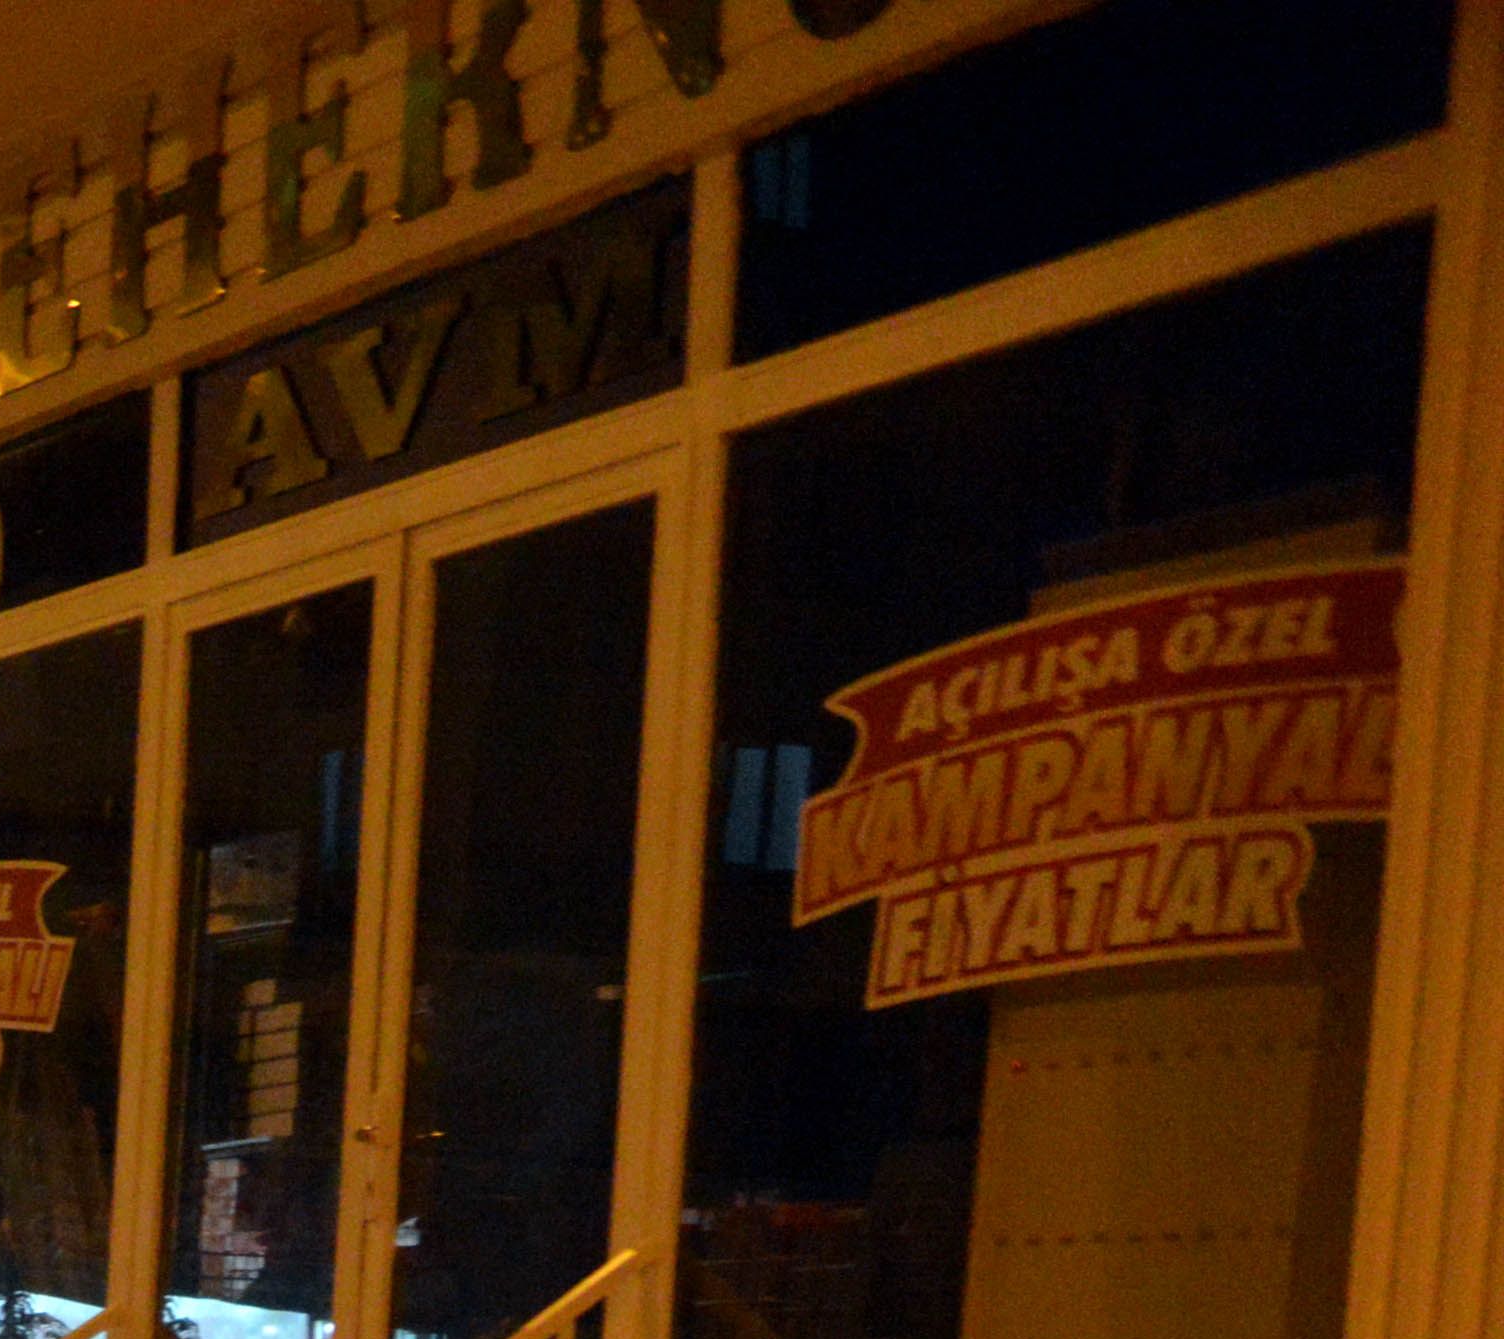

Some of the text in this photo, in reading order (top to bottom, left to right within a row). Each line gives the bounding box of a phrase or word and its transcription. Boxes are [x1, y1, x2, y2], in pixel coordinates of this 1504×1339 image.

[223, 205, 689, 510] AVM
[896, 590, 1339, 742] AÇILIŞA ÖZEL
